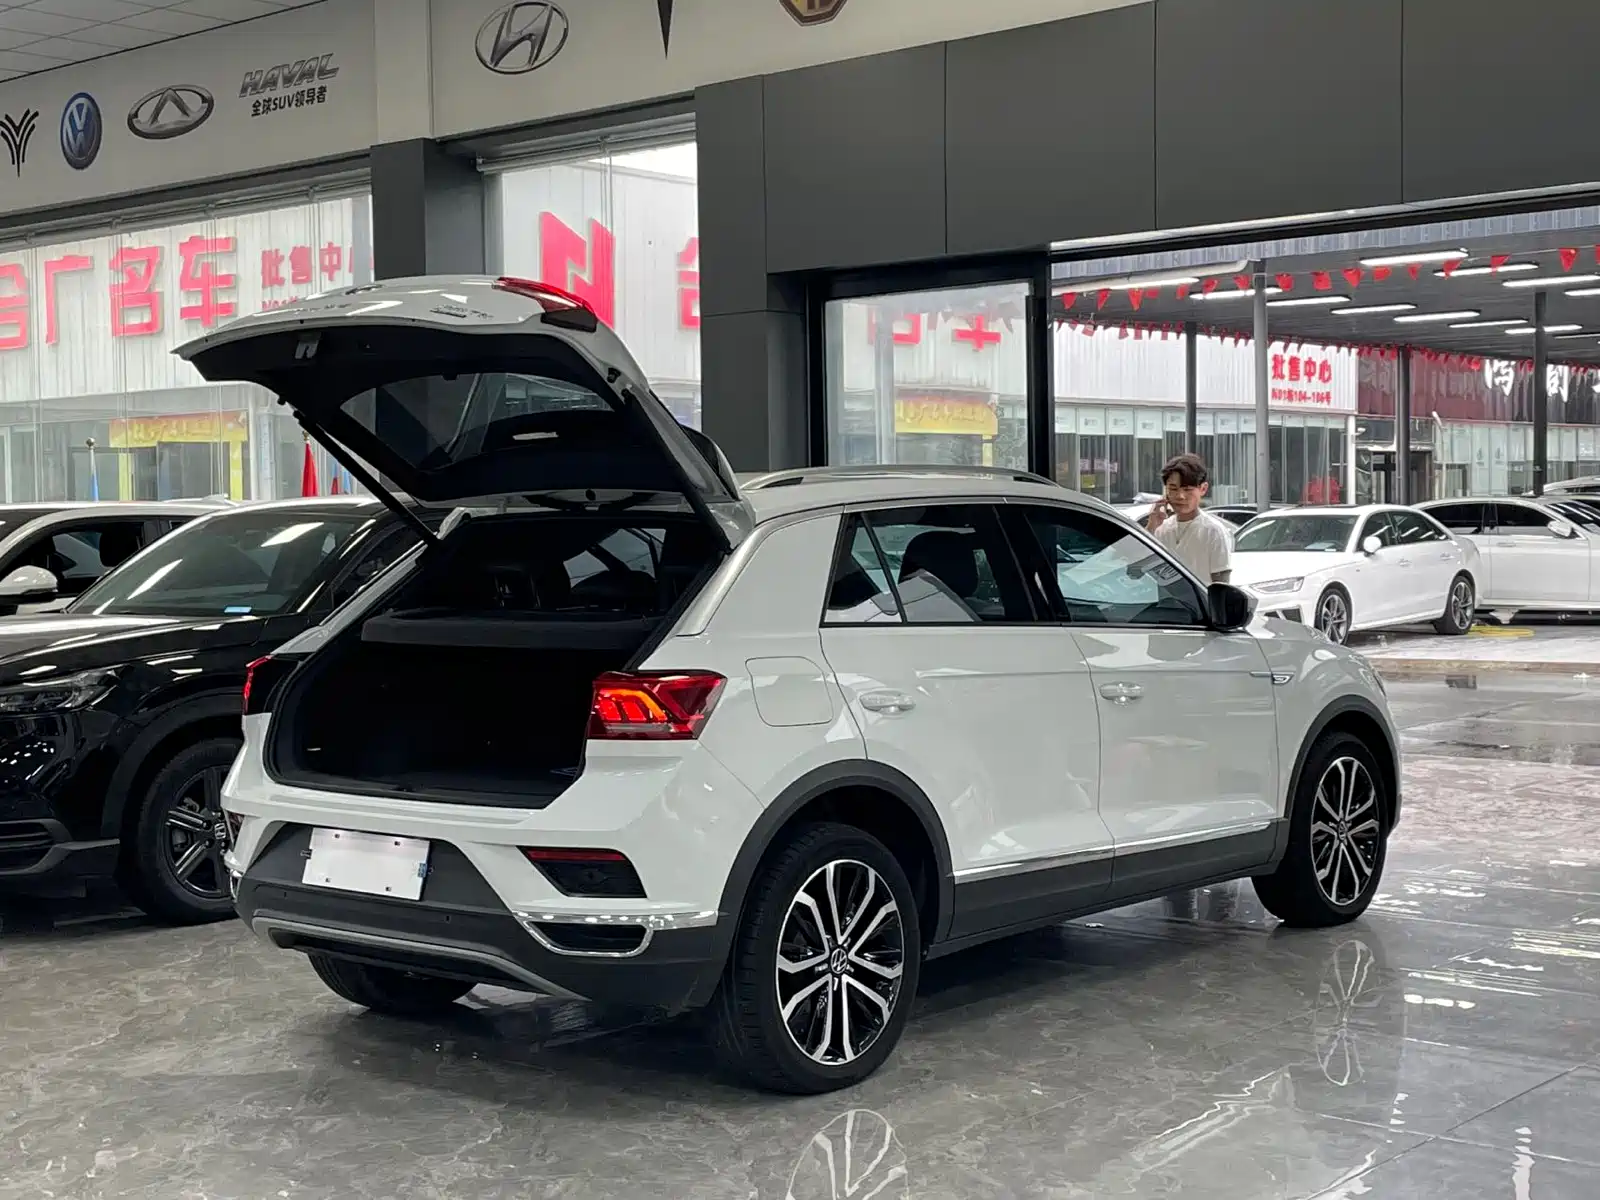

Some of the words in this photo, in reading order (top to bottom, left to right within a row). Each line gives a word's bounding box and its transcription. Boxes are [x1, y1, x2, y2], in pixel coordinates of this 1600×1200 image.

[239, 53, 339, 98] HAVAL
[251, 85, 328, 117] 全球SUV领导者
[261, 241, 353, 288] 批售中
[1272, 354, 1332, 384] 批售中心
